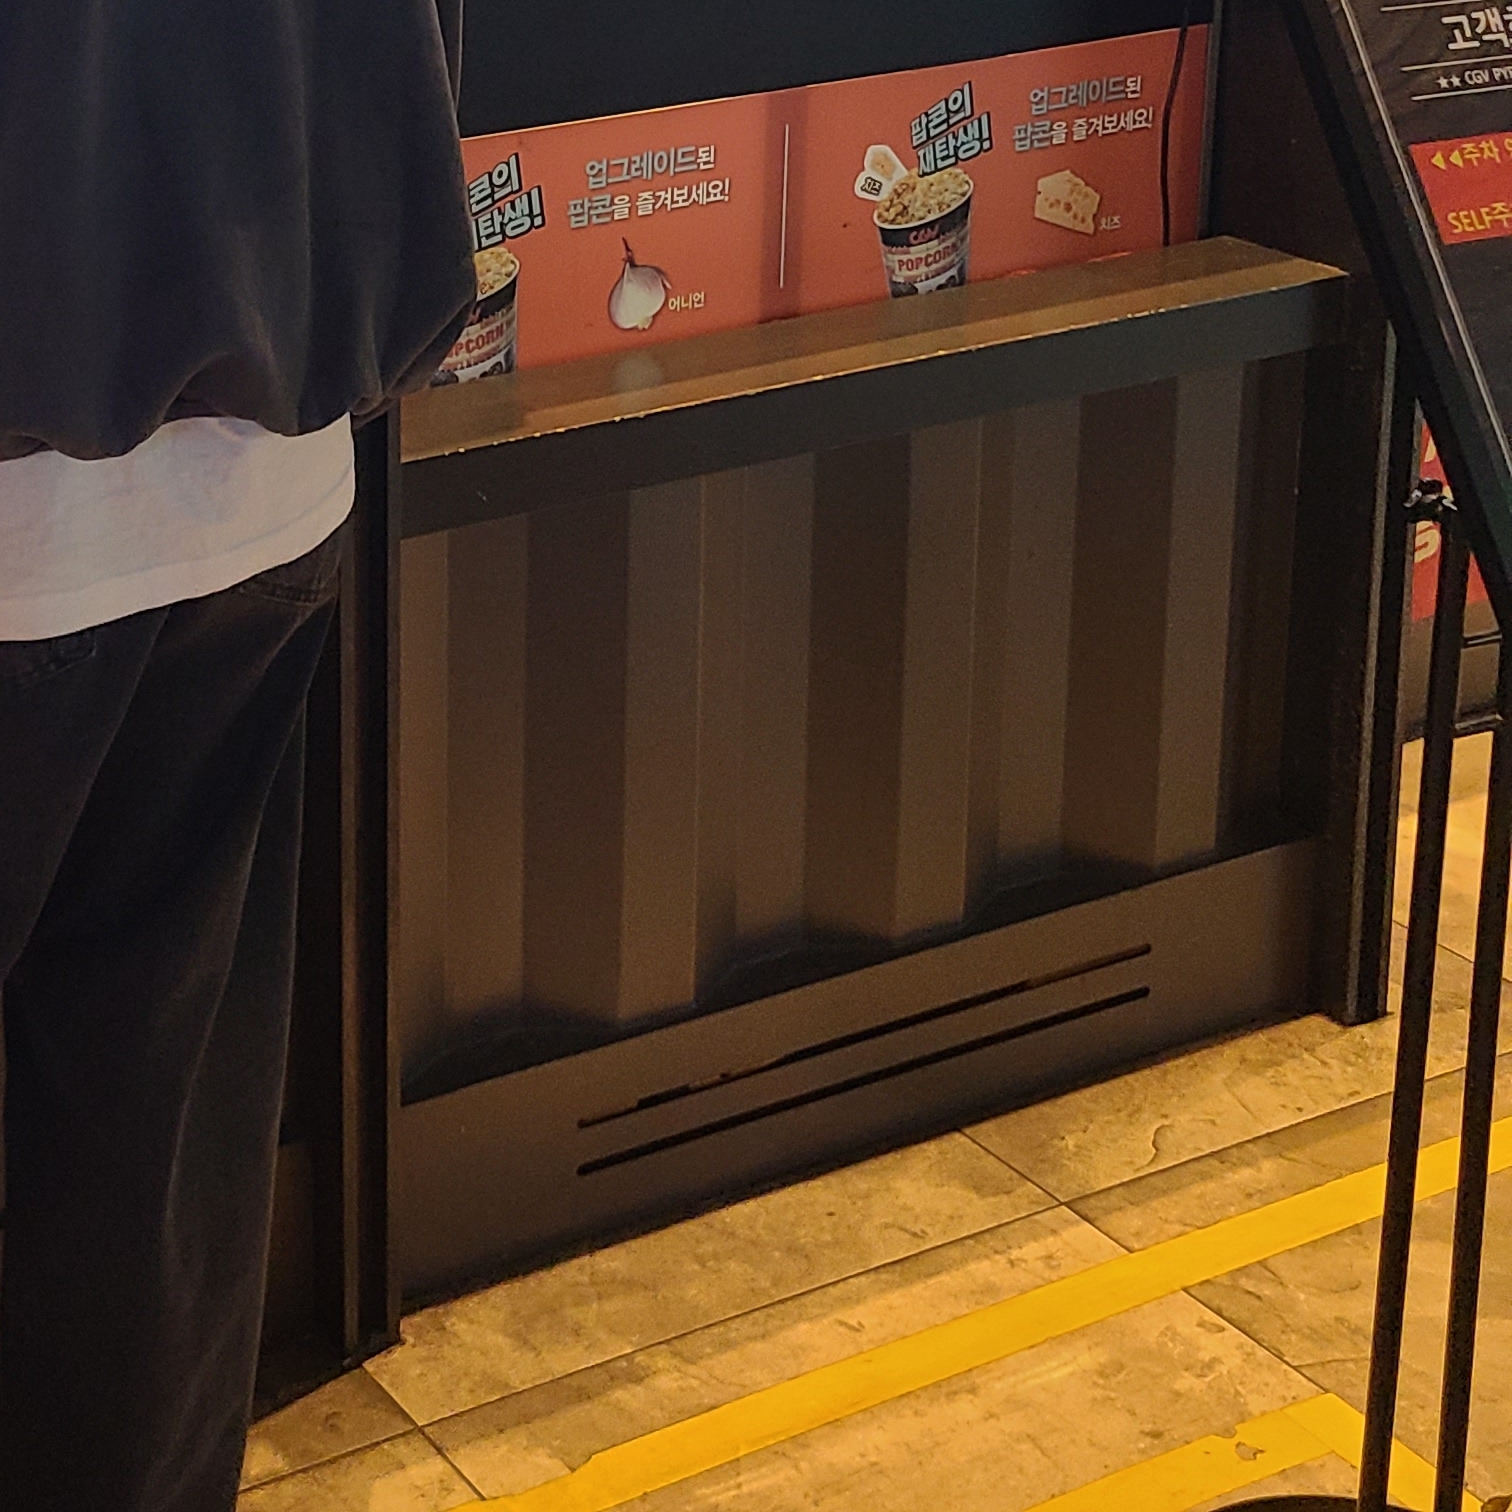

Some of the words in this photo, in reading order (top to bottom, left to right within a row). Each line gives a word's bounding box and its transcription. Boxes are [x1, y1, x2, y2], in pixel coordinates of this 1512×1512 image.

[1028, 74, 1143, 117] 업그레이드된
[1464, 68, 1489, 86] CGV
[910, 79, 976, 150] 팝콘의
[1012, 121, 1069, 153] 팝콘을
[1071, 105, 1155, 144] 즐겨보세요!
[917, 110, 994, 179] 재탄생!
[1462, 140, 1502, 168] 주차
[585, 144, 717, 190] 업그레이드된
[567, 194, 632, 230] 팝콘을
[634, 177, 731, 217] 즐겨보세요!
[1098, 215, 1122, 231] 치즈
[668, 291, 706, 312] 어니언
